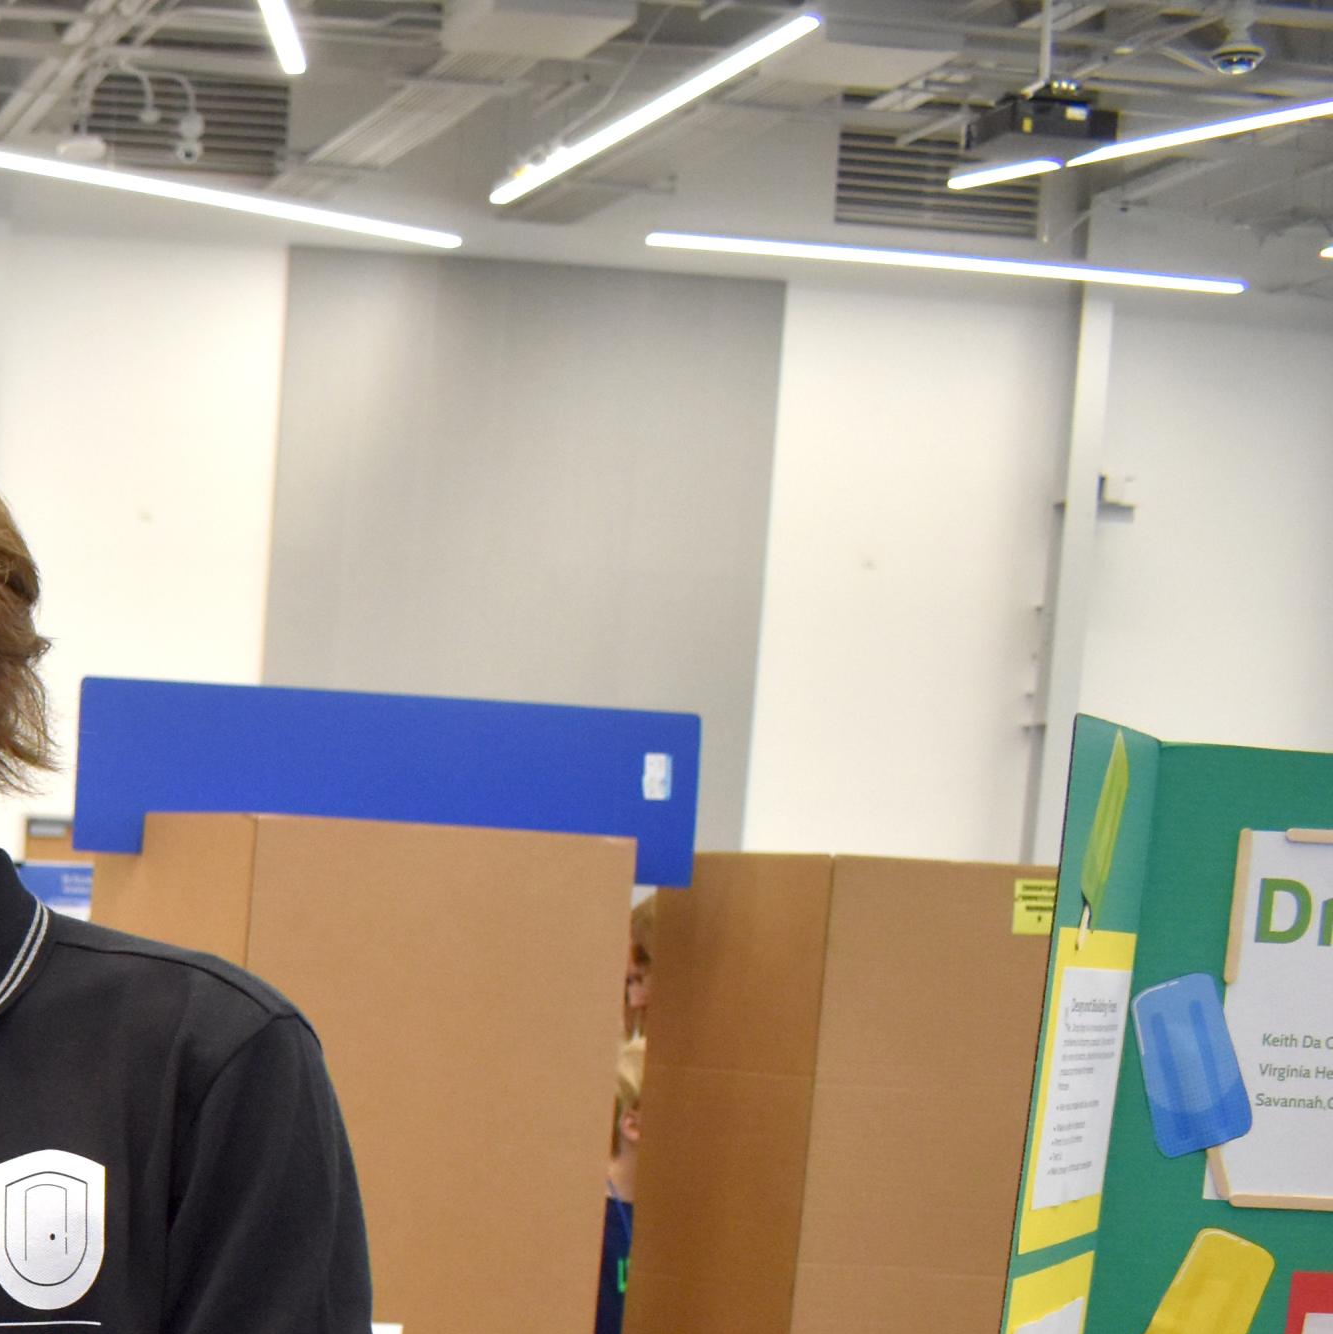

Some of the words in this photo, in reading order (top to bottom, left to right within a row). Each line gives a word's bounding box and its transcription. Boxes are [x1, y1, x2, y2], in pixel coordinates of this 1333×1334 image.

[1262, 1034, 1299, 1048] Keith
[1302, 1035, 1322, 1049] Da
[1259, 1063, 1312, 1082] Virginia
